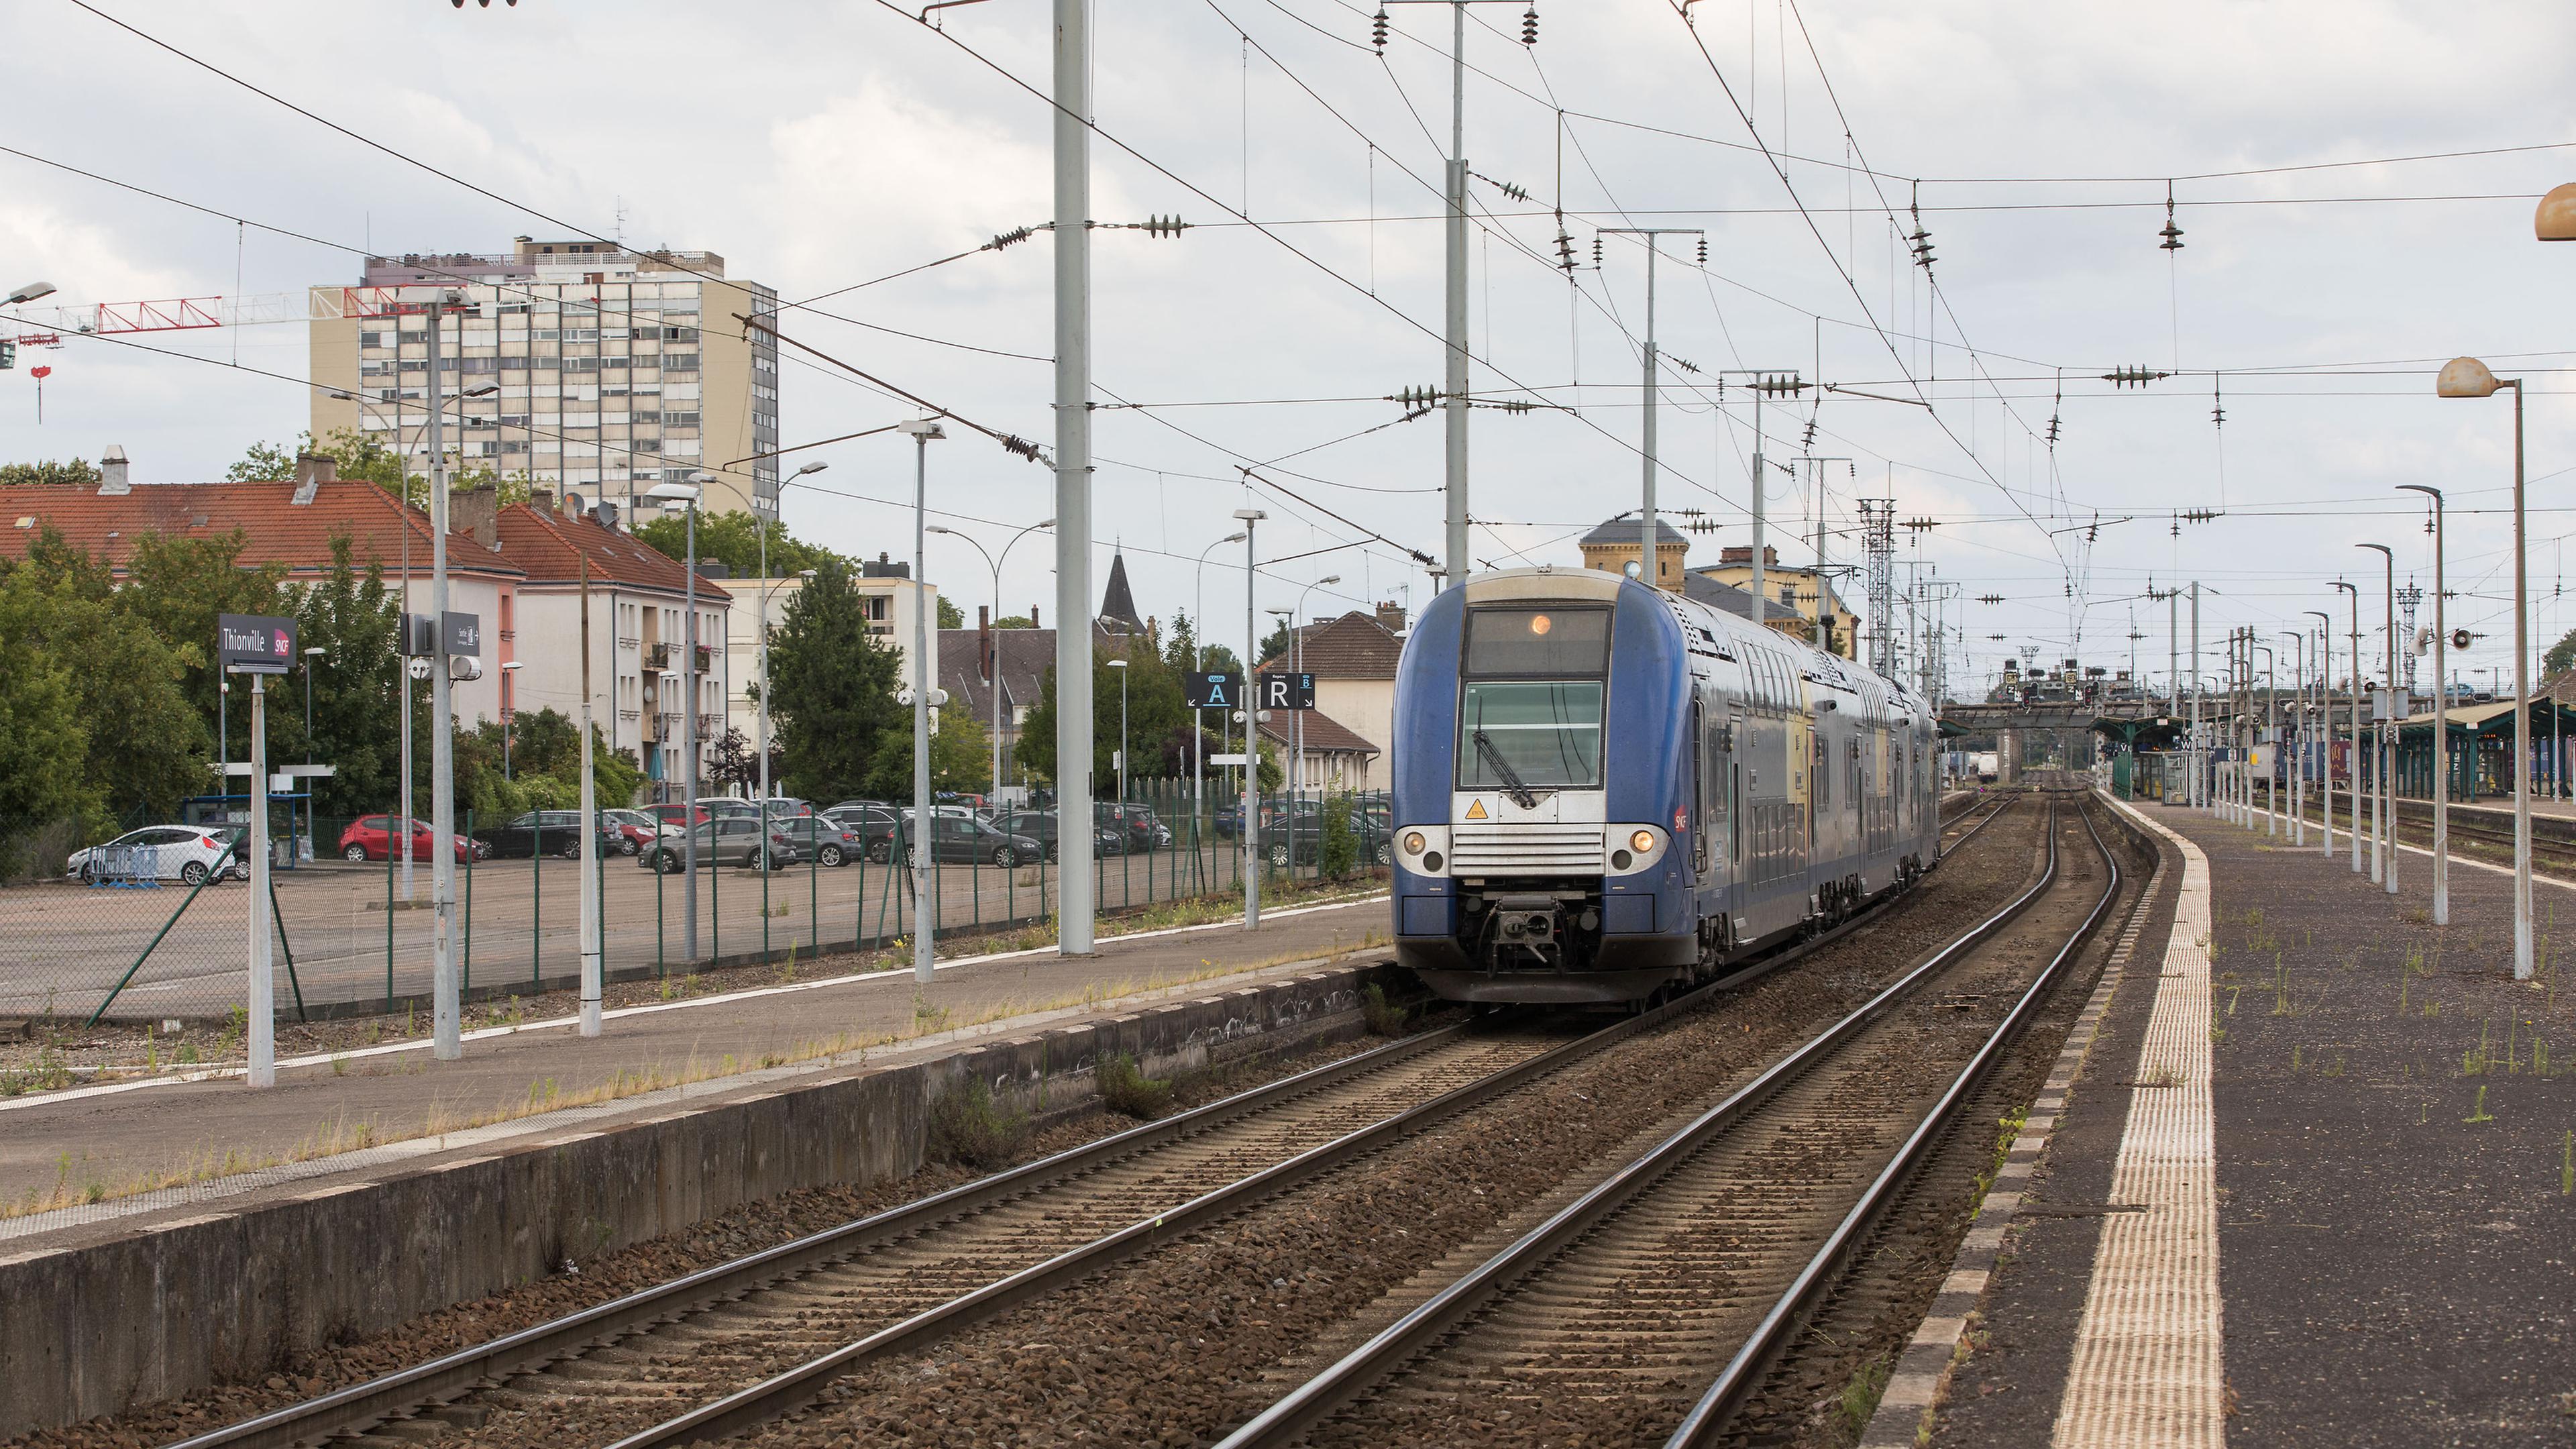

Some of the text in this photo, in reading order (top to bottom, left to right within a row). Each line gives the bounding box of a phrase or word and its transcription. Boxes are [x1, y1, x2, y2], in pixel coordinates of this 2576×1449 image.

[223, 628, 289, 653] Thionville SNCF
[1303, 679, 1309, 687] B
[1208, 684, 1226, 703] A
[1271, 681, 1289, 706] R
[1675, 815, 1686, 828] SNCF
